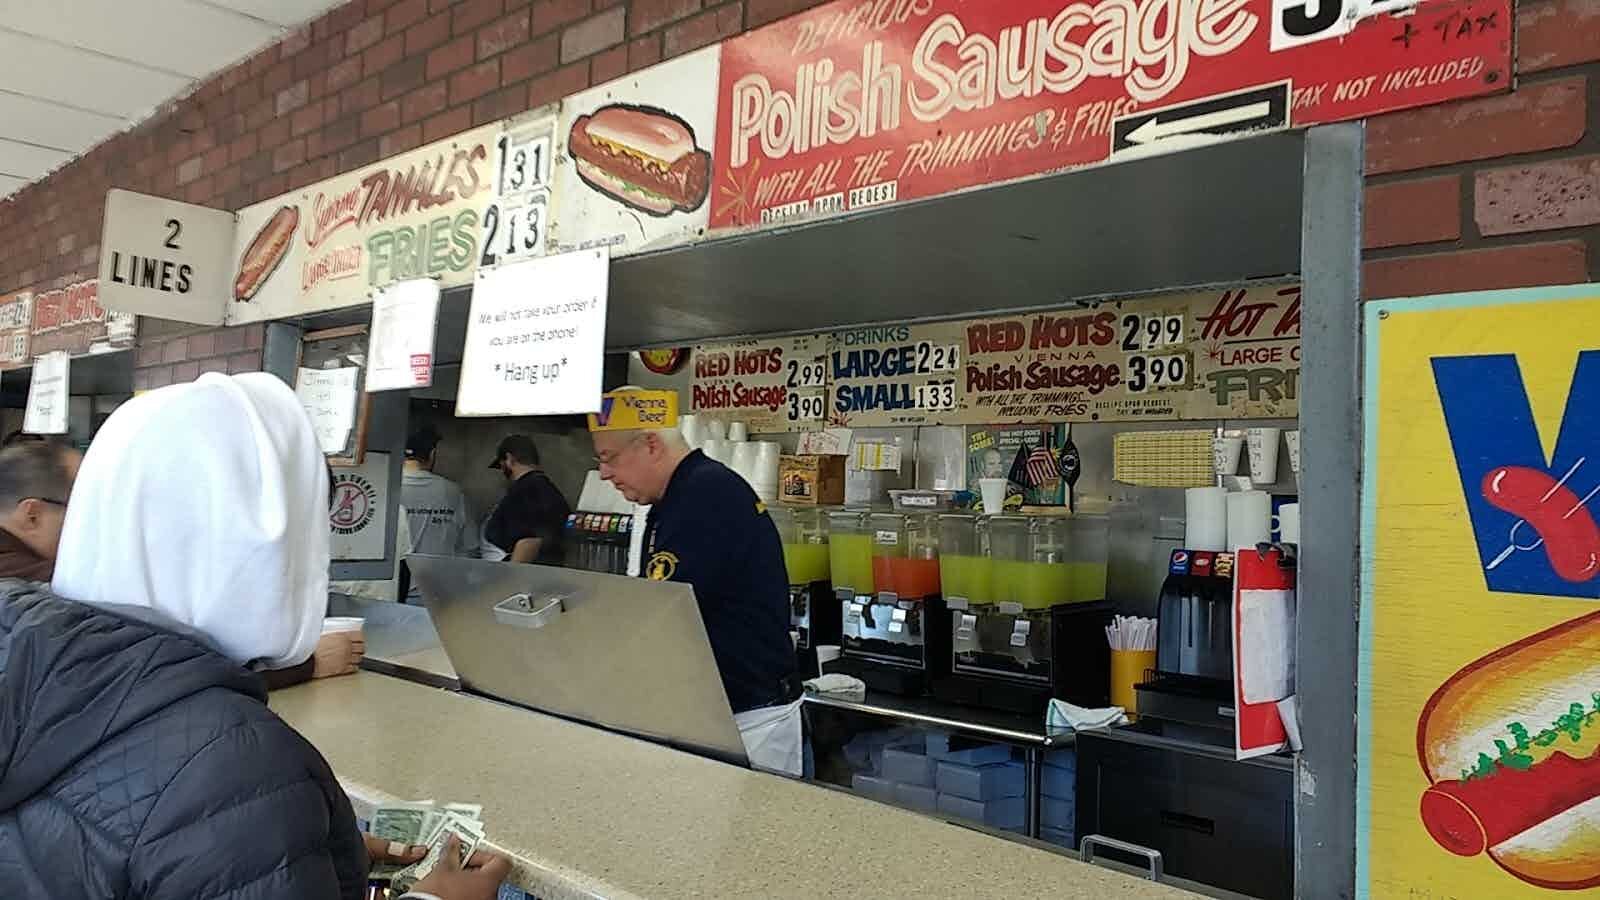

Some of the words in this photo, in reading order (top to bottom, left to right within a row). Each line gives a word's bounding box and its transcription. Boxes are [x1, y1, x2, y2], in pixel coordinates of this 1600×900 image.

[1434, 8, 1498, 43] TAX
[731, 40, 902, 168] Polish
[908, 0, 1259, 121] Sausage
[1291, 84, 1328, 110] TAX
[1333, 76, 1377, 103] NOT
[1381, 56, 1484, 93] INCLUDED
[752, 169, 804, 208] WITH
[800, 158, 843, 195] ALL
[847, 150, 894, 187] THE
[898, 109, 1055, 178] TRIMMINGS
[1051, 107, 1067, 151] &
[357, 144, 487, 228] TAMALES
[165, 219, 182, 249] 2
[366, 209, 478, 286] FRIES
[111, 250, 193, 294] LINES
[543, 304, 561, 317] your
[563, 300, 588, 313] order
[1196, 288, 1278, 340] HOT
[844, 327, 910, 346] DRINKS
[967, 321, 1026, 355] RED
[1029, 311, 1117, 350] HOTS
[504, 362, 539, 385] Hang
[695, 351, 731, 379] RED
[734, 346, 784, 376] HOTS
[831, 345, 916, 380] LARGE
[1014, 351, 1096, 363] VIENNA
[1220, 347, 1282, 366] LARGE
[966, 363, 1023, 393] Polish
[1024, 361, 1122, 395] Sausage
[1206, 367, 1300, 405] FRI
[692, 383, 732, 410] Polish
[732, 381, 788, 412] Sausage
[835, 383, 916, 413] SMALL
[1044, 404, 1088, 416] FRIES
